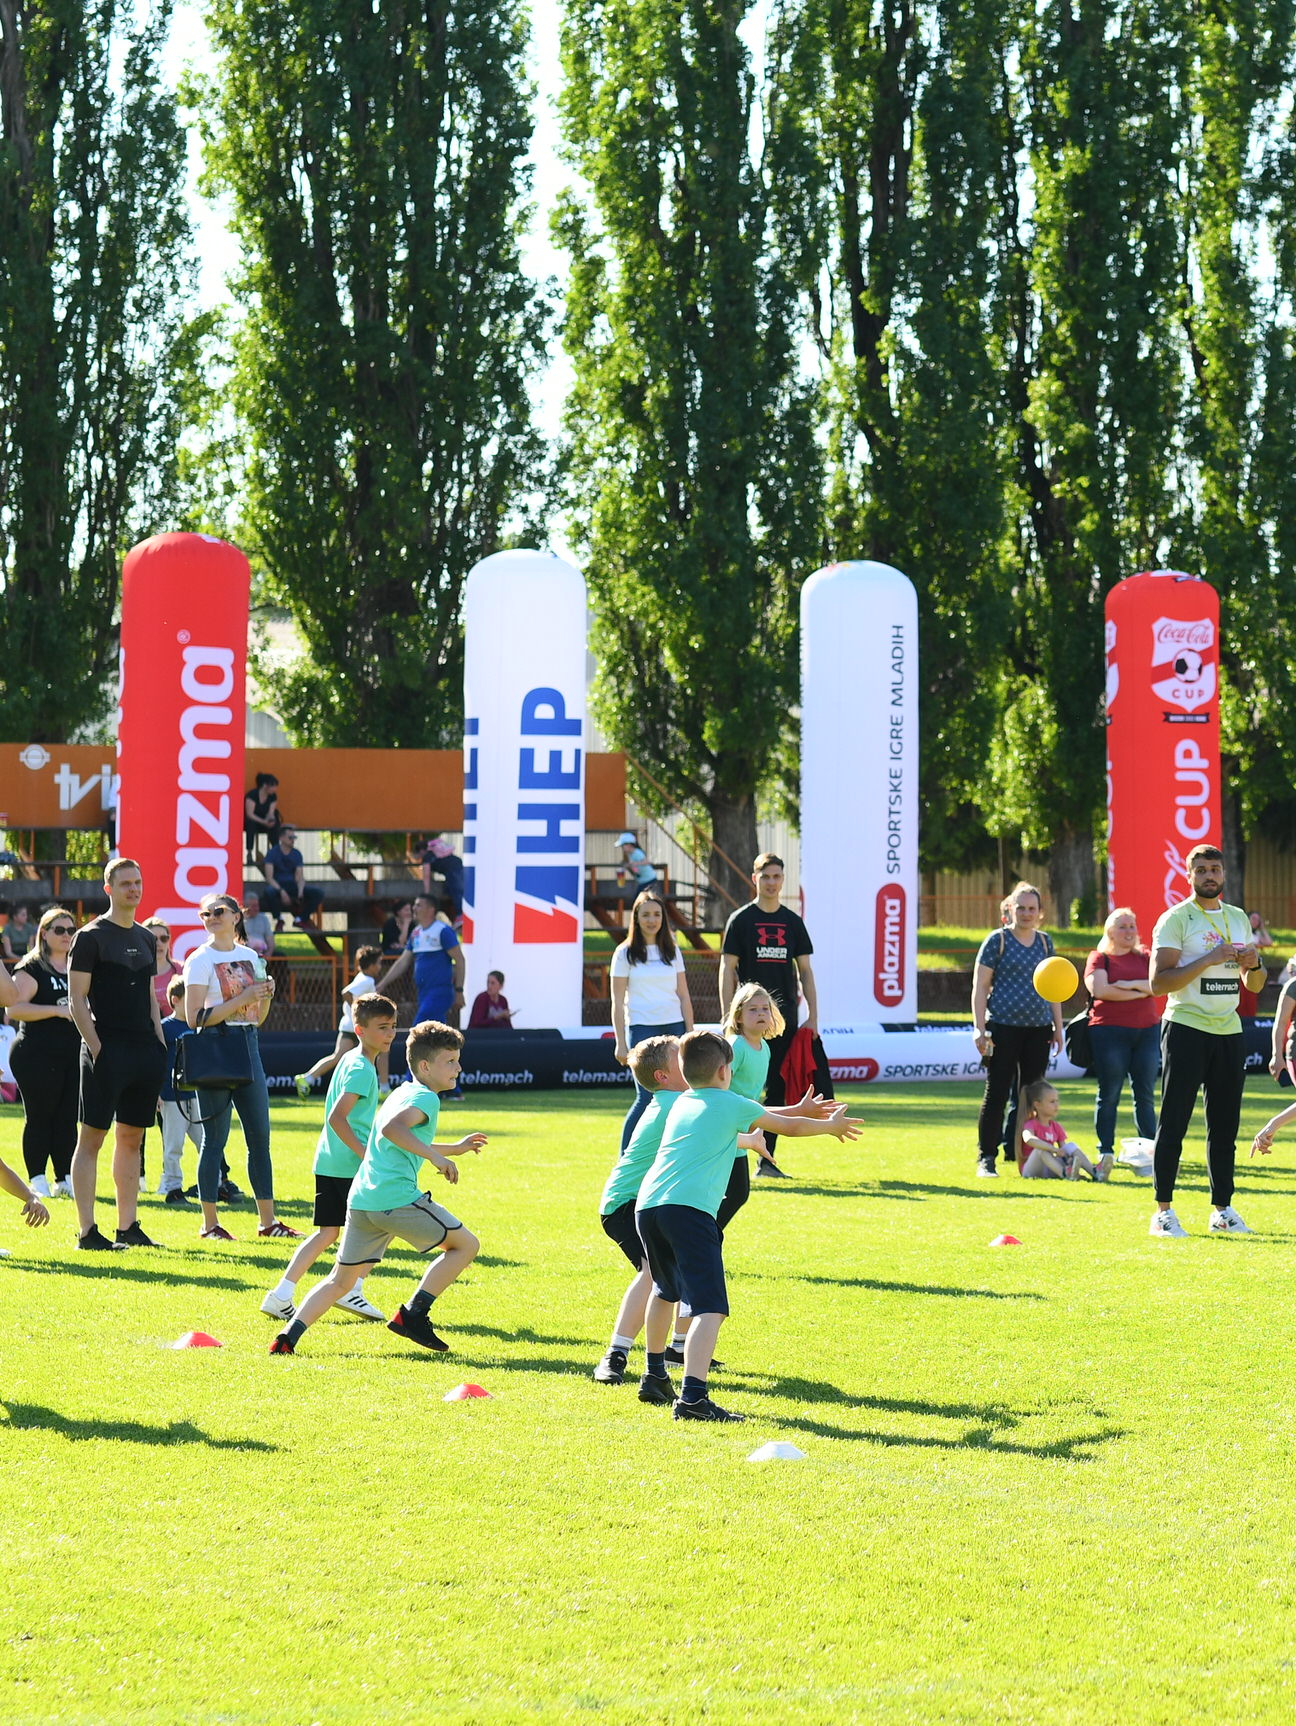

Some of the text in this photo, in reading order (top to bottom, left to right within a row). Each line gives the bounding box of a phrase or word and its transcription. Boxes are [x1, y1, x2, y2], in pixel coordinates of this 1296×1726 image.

[1171, 688, 1205, 699] CUP
[887, 625, 905, 874] SPORTSKE IGRE MLADIH
[54, 763, 117, 811] tvi
[516, 687, 582, 854] HEP
[1174, 738, 1211, 840] CUP
[756, 946, 788, 954] UNDER
[878, 898, 903, 997] plazma
[459, 1069, 534, 1084] telemach
[562, 1069, 634, 1083] telemach
[829, 1062, 986, 1080] zma SPORTSKE IGR
